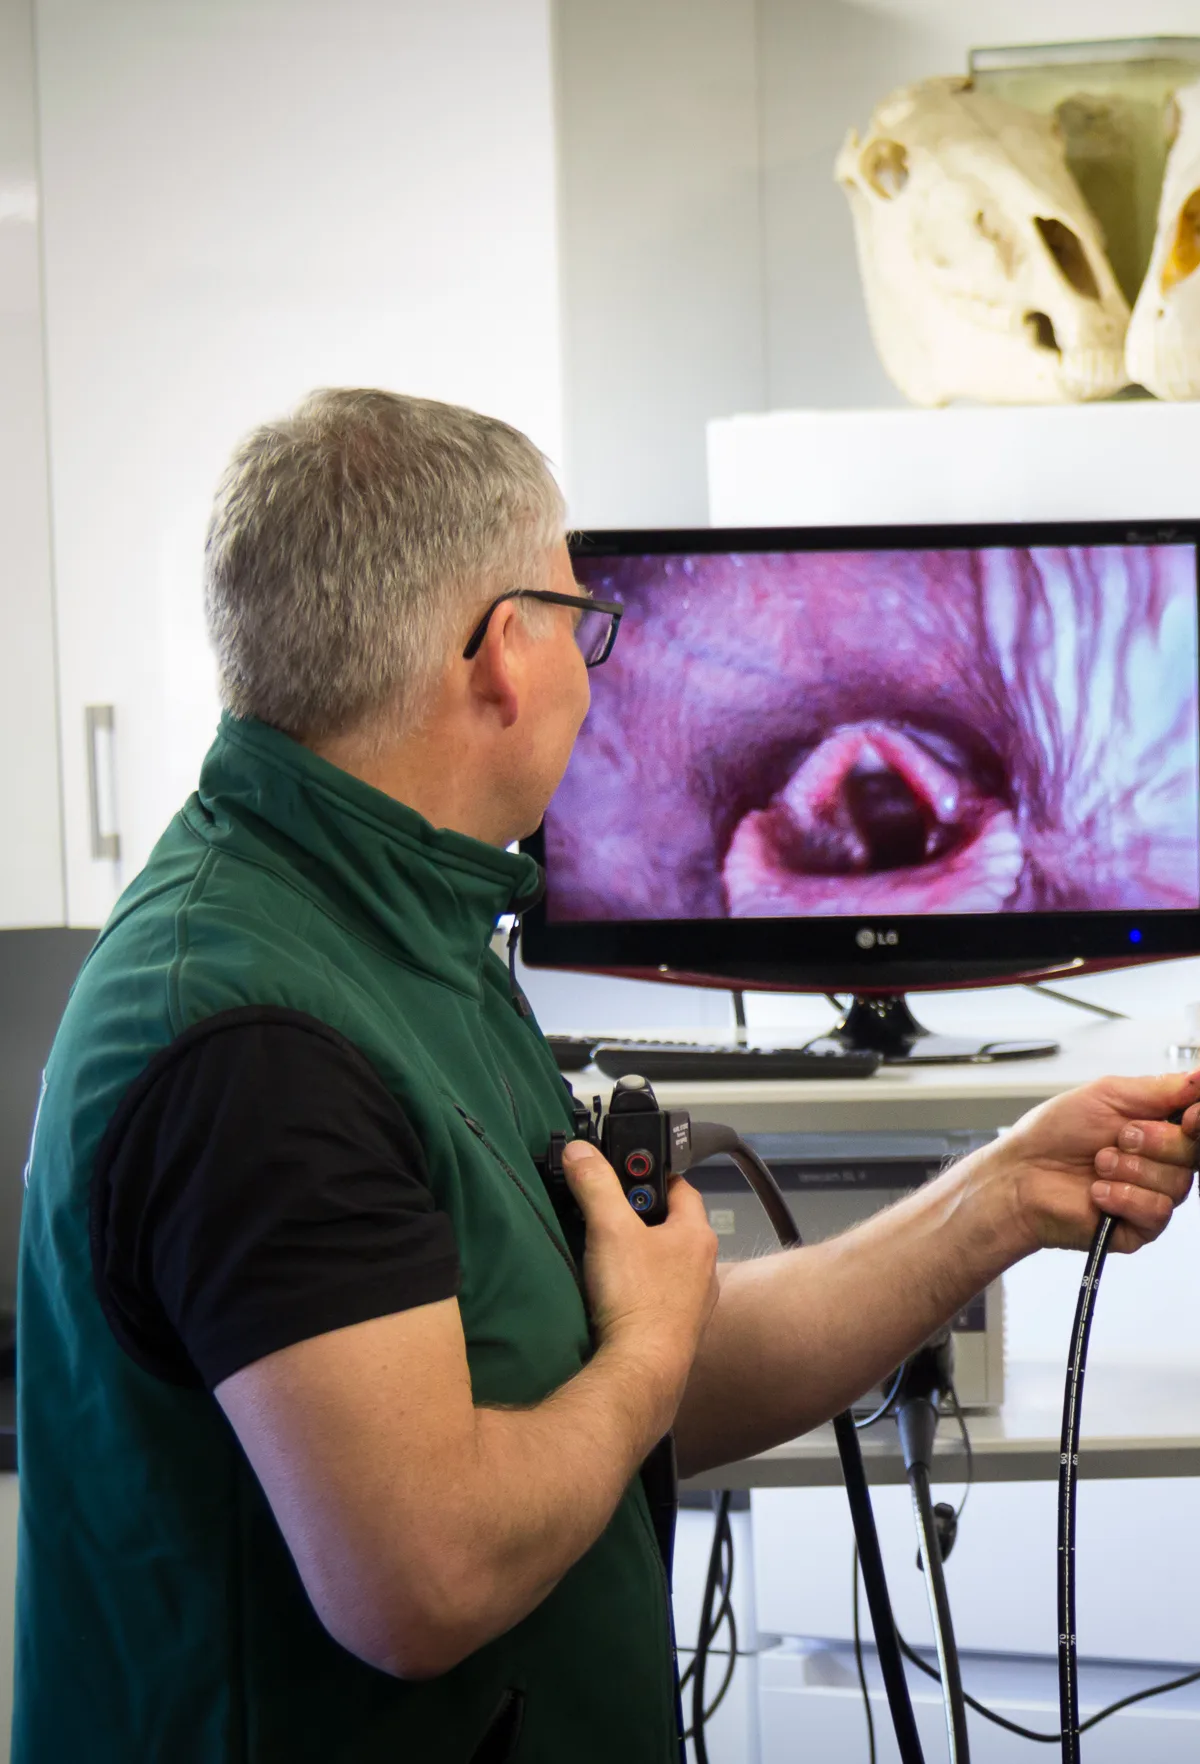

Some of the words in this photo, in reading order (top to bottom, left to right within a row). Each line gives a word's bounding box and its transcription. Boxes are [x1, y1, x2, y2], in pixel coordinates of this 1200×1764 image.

[1081, 1275, 1089, 1287] 50
[1060, 1452, 1068, 1465] 60
[1059, 1633, 1067, 1646] 70
